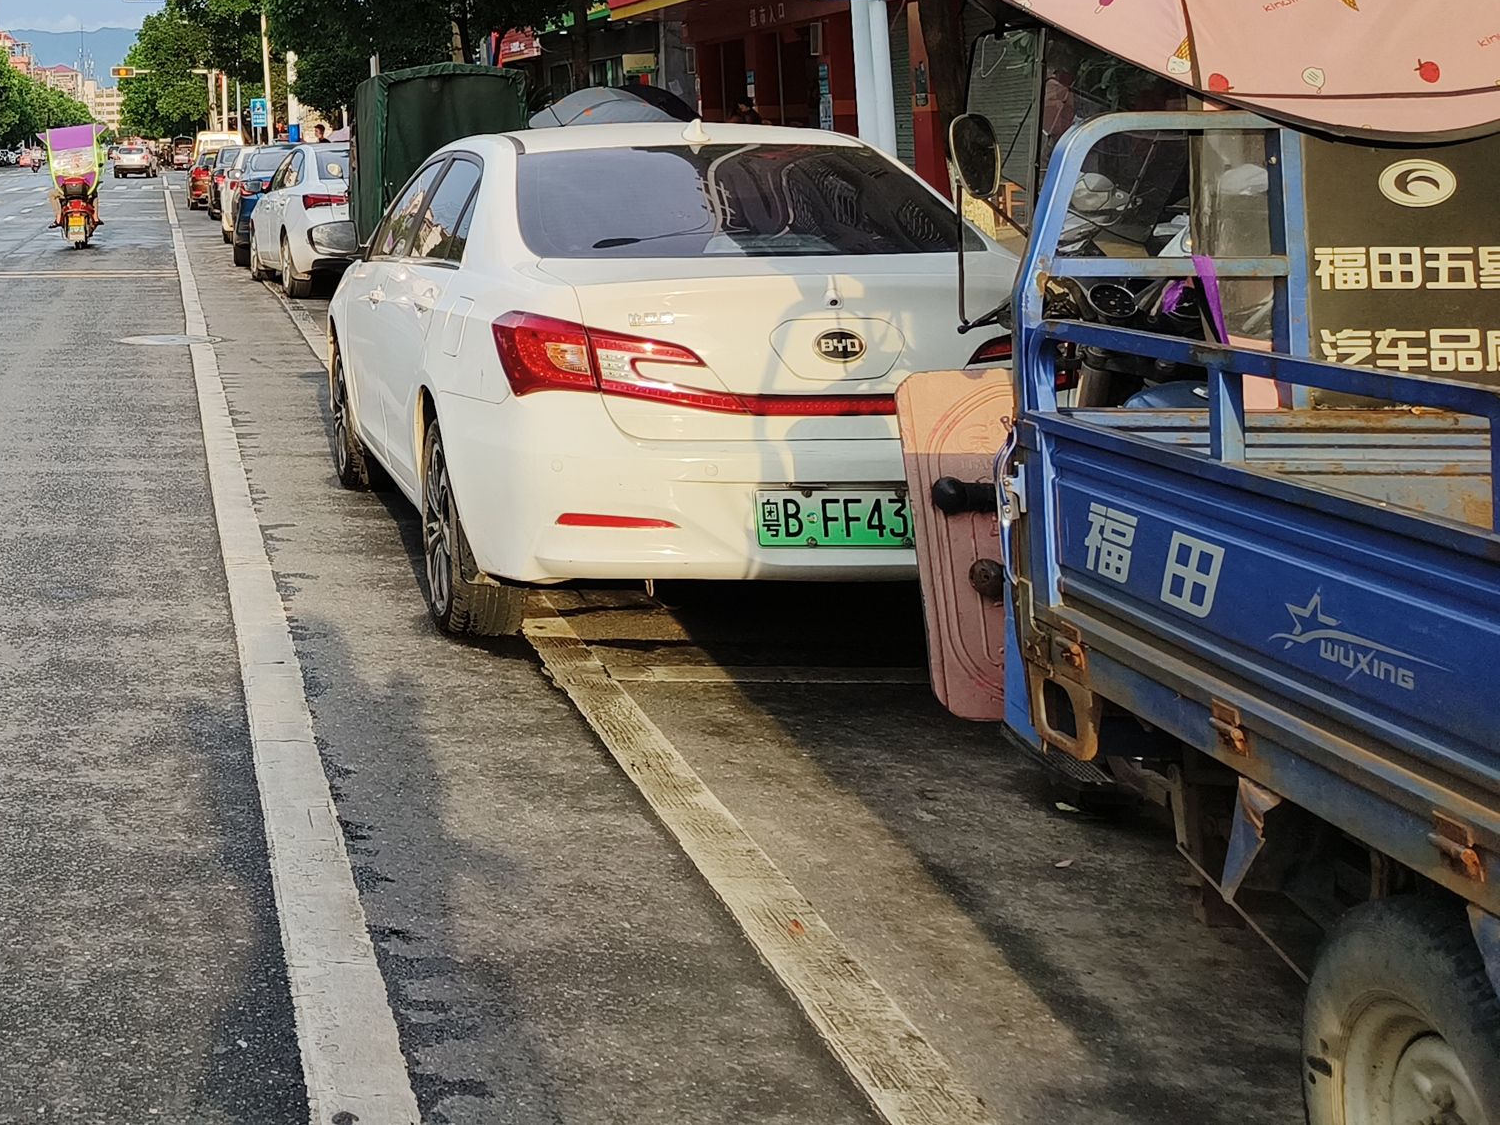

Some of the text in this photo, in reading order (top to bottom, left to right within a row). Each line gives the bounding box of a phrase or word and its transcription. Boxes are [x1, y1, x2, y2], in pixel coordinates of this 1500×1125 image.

[820, 338, 861, 353] BYD
[1320, 328, 1500, 373] 汽车品
[1084, 502, 1226, 618] 福田
